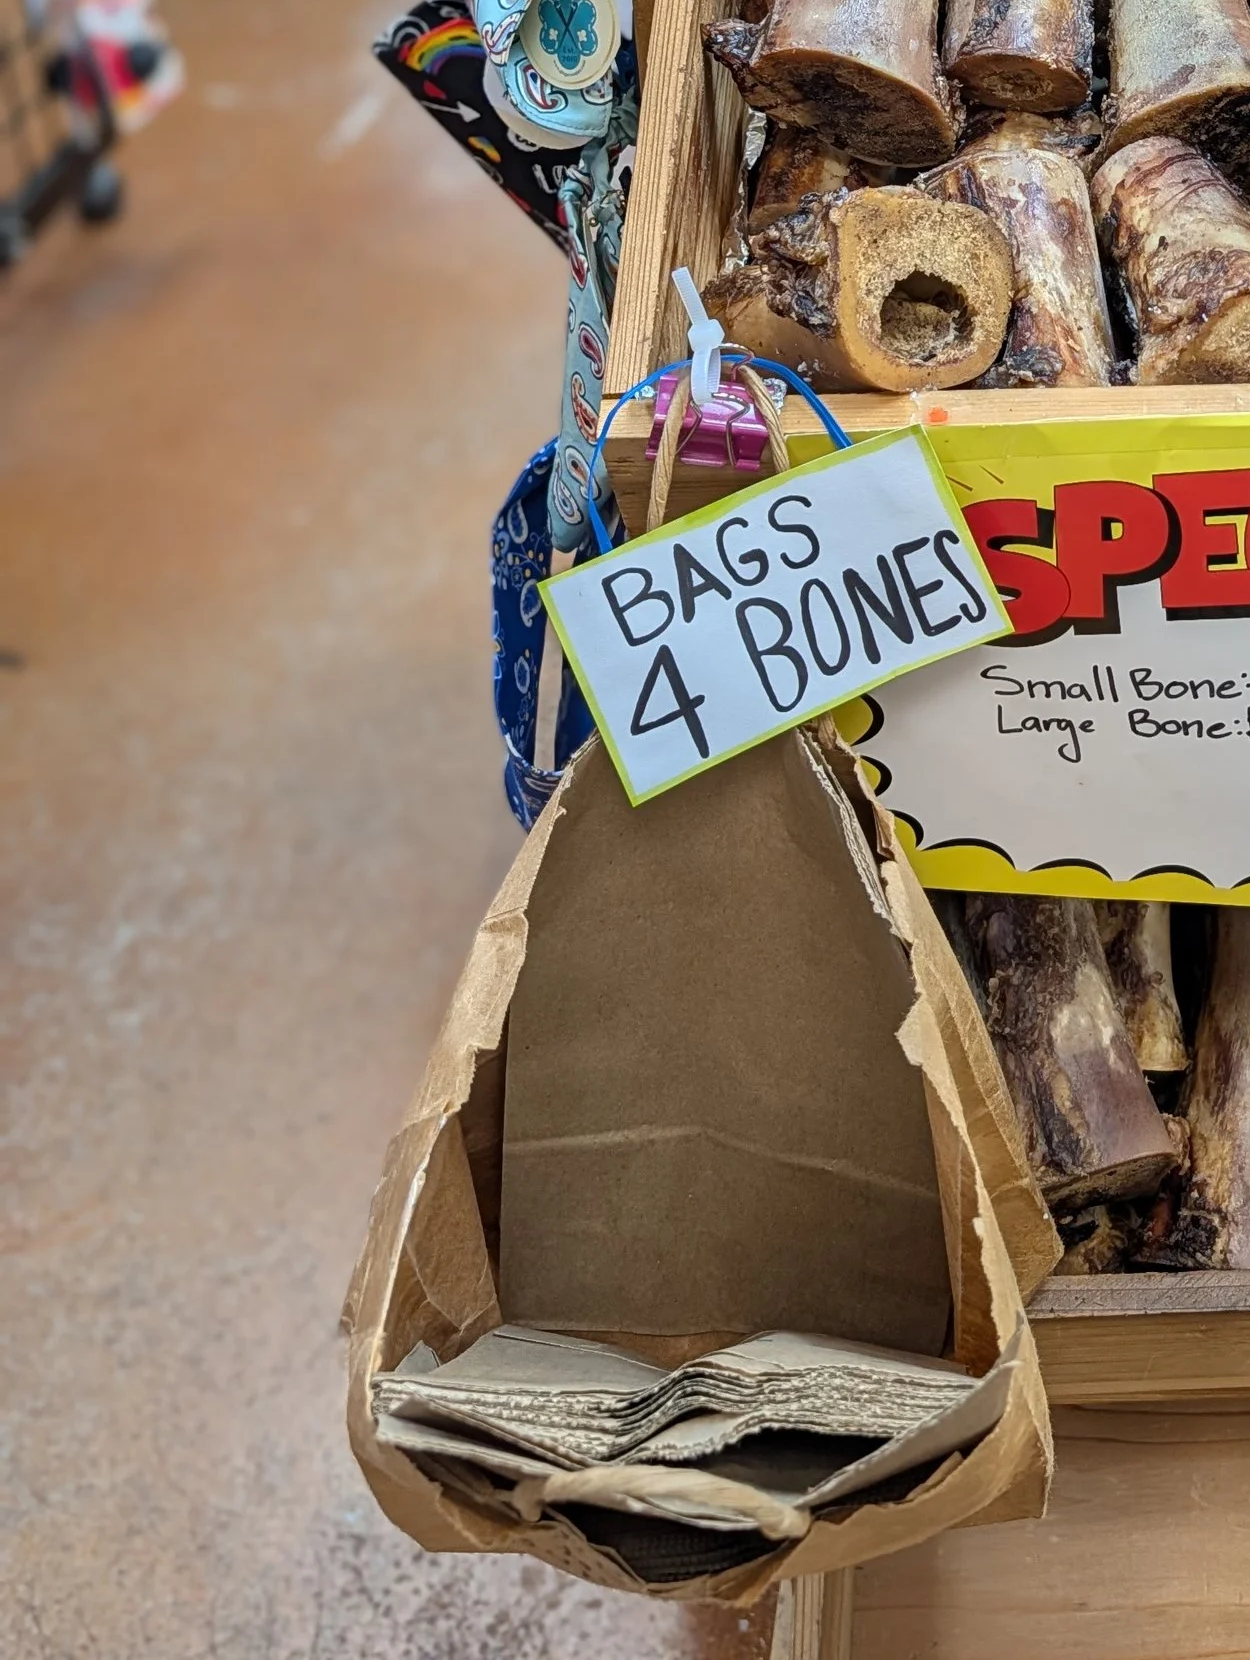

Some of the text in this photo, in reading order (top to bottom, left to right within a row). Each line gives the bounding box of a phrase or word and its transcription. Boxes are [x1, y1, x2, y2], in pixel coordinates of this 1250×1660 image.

[601, 494, 822, 647] BAGS
[630, 529, 988, 758] 4 BONES
[979, 664, 1120, 703] Small
[997, 704, 1095, 763] Large
